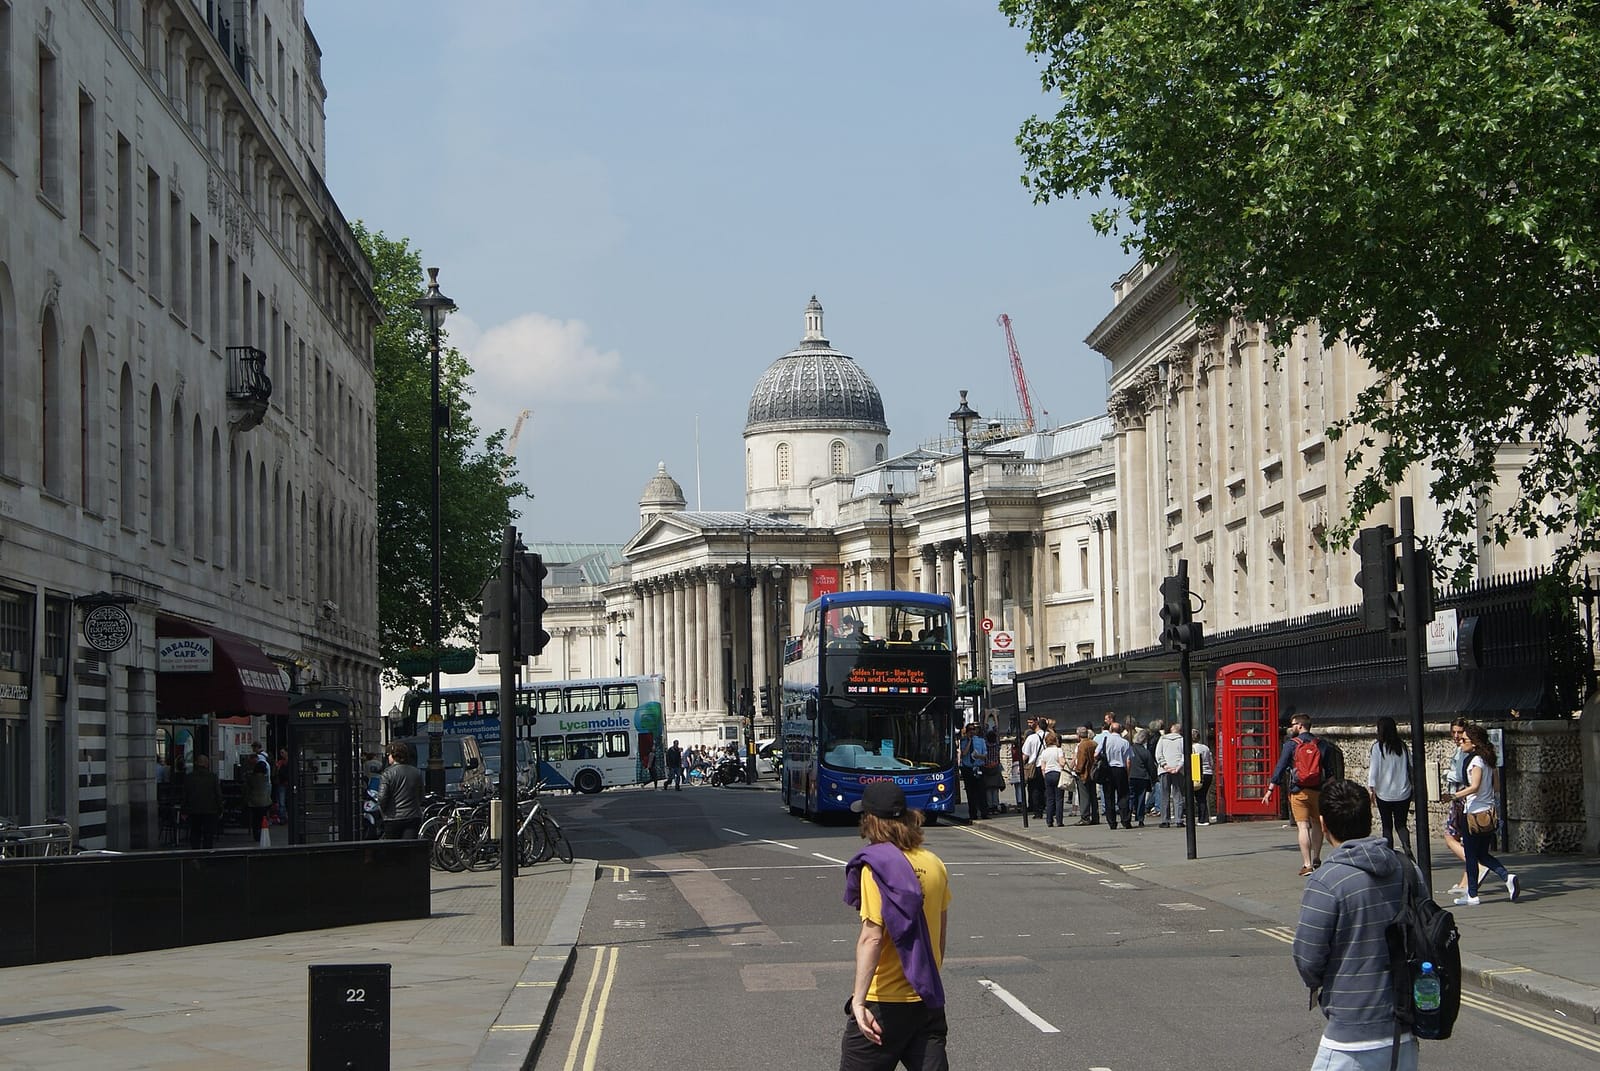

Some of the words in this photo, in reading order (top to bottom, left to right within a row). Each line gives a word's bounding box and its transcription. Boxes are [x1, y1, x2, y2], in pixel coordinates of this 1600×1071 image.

[982, 620, 990, 630] G
[160, 640, 210, 657] BREADLINE
[457, 725, 500, 734] International
[560, 716, 630, 732] Lycamobile
[931, 773, 945, 781] 109
[346, 988, 366, 1002] 22
